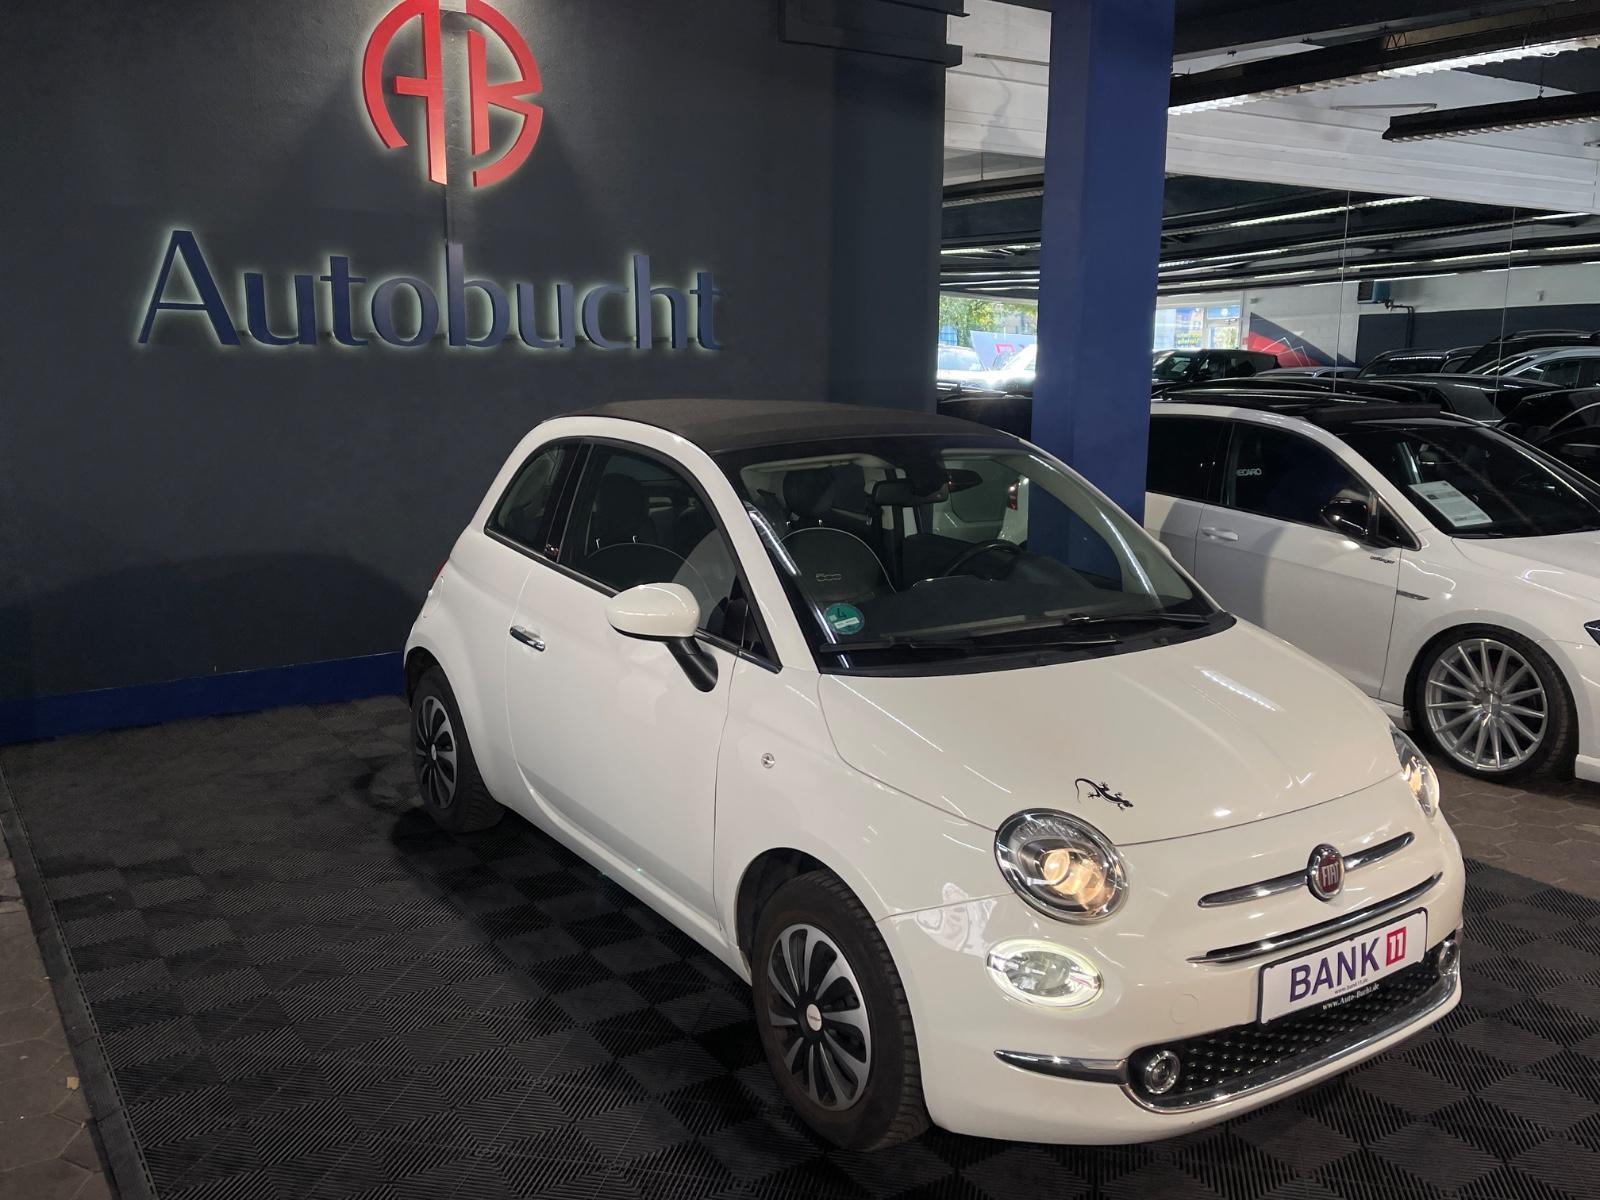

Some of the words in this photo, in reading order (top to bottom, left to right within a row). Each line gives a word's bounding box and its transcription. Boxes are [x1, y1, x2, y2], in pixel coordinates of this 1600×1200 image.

[138, 229, 724, 349] Autobucht
[1321, 861, 1339, 887] FIAT
[1289, 936, 1380, 1002] BANK
